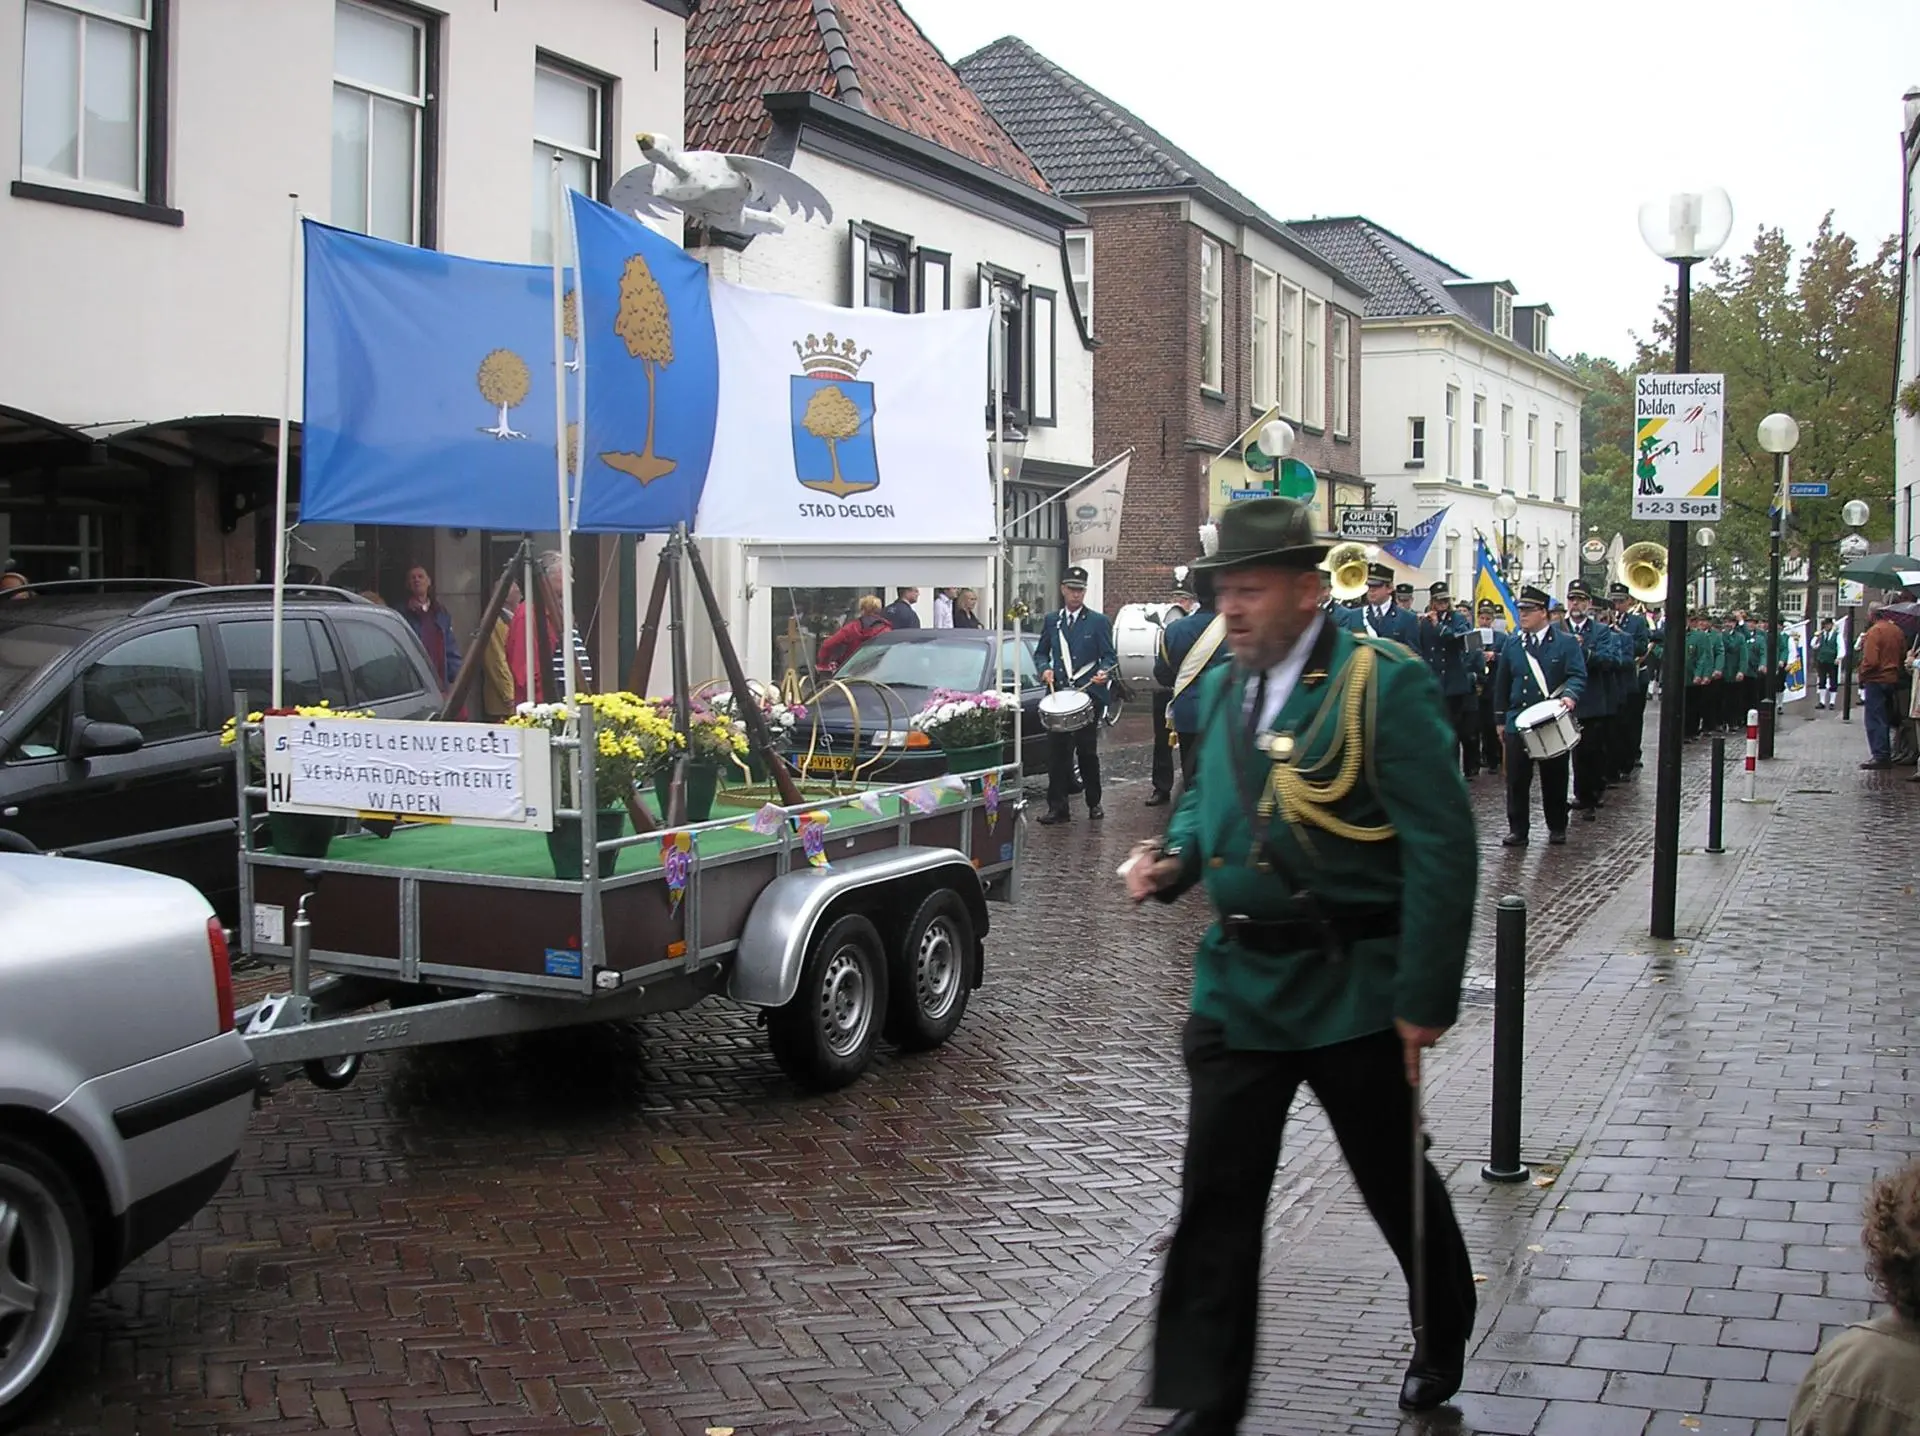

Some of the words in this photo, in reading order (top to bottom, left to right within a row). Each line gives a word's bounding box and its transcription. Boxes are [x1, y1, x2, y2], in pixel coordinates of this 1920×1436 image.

[1638, 378, 1721, 396] Schuttersfeest
[1638, 398, 1676, 415] Delden
[799, 503, 835, 518] STAD
[838, 504, 895, 518] DELDEN
[1349, 512, 1387, 521] OPTIEK
[1637, 502, 1675, 513] 1-2-3
[1680, 502, 1717, 516] Sept
[1347, 526, 1388, 536] AARSEN
[368, 791, 441, 812] WAPEN
